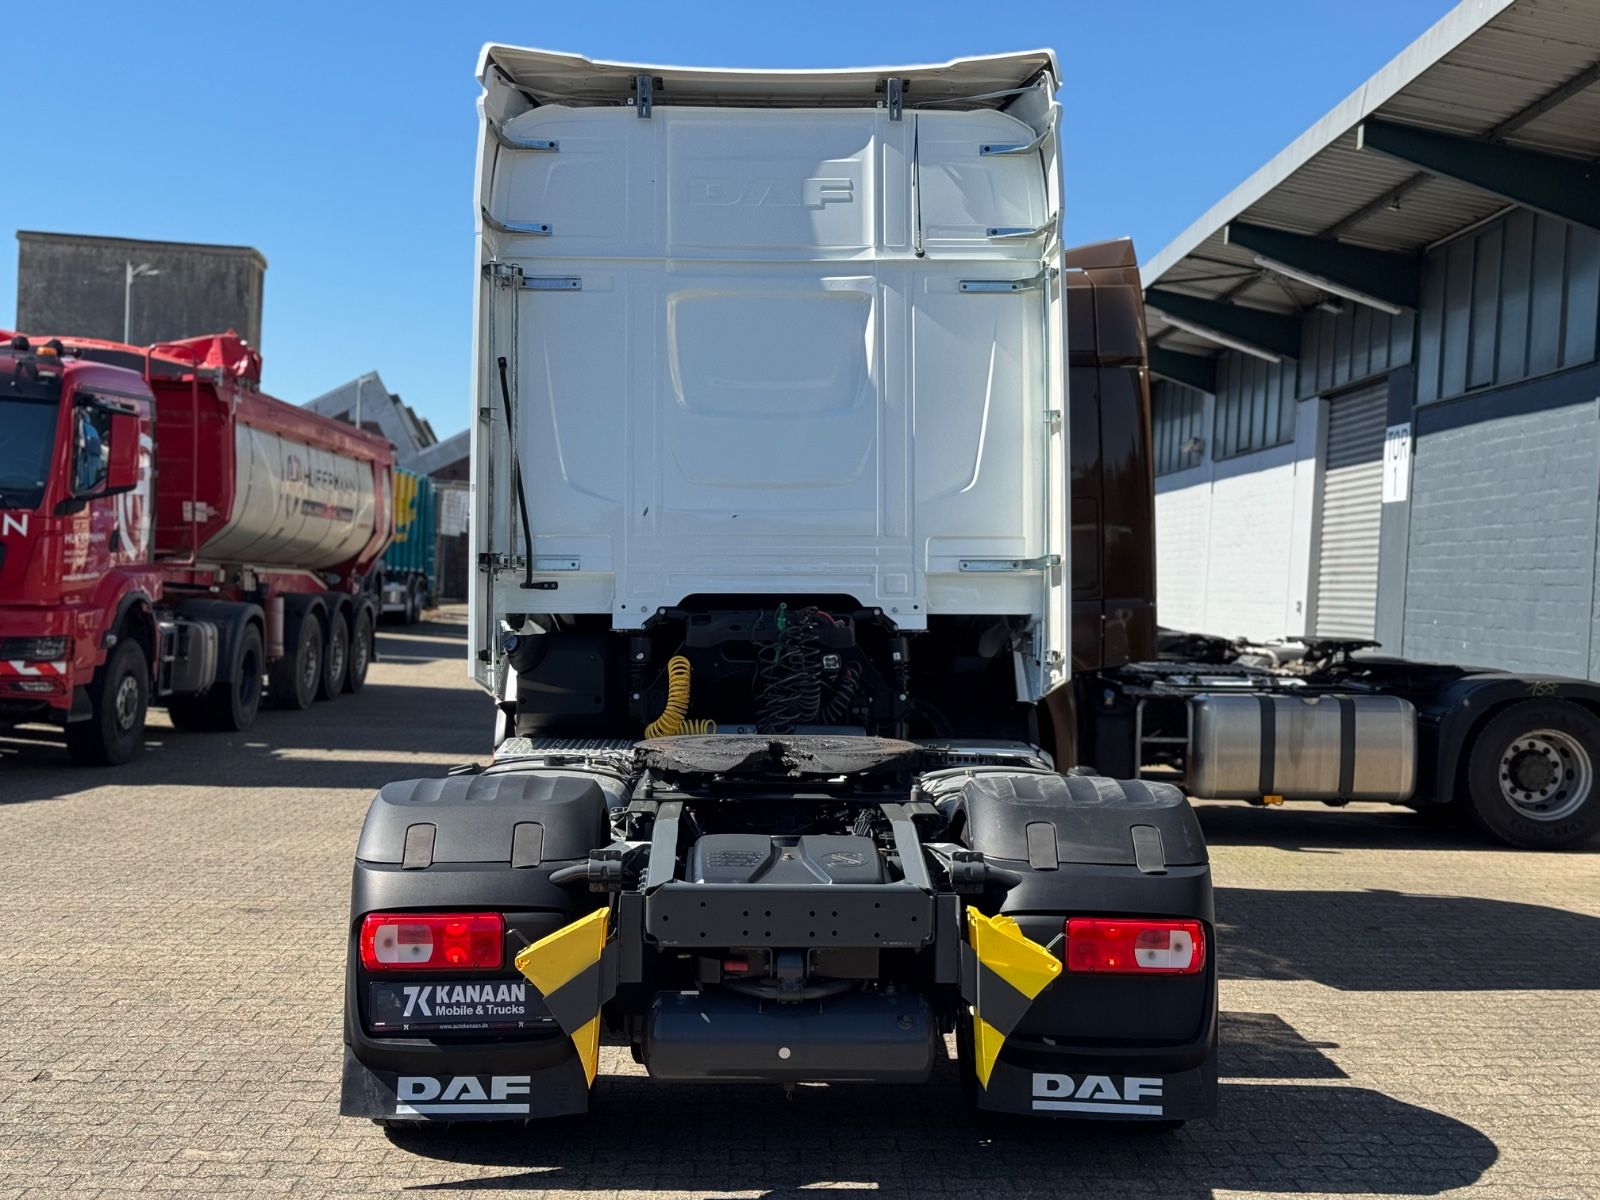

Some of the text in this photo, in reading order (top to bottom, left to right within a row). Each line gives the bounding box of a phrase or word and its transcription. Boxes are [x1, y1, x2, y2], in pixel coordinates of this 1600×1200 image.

[687, 176, 853, 209] DAF
[1387, 427, 1409, 462] TOR
[436, 984, 526, 1004] KANAAN
[435, 1004, 525, 1017] Mobile & Trucks
[397, 1076, 531, 1101] DAF
[1032, 1073, 1163, 1101] DAF
